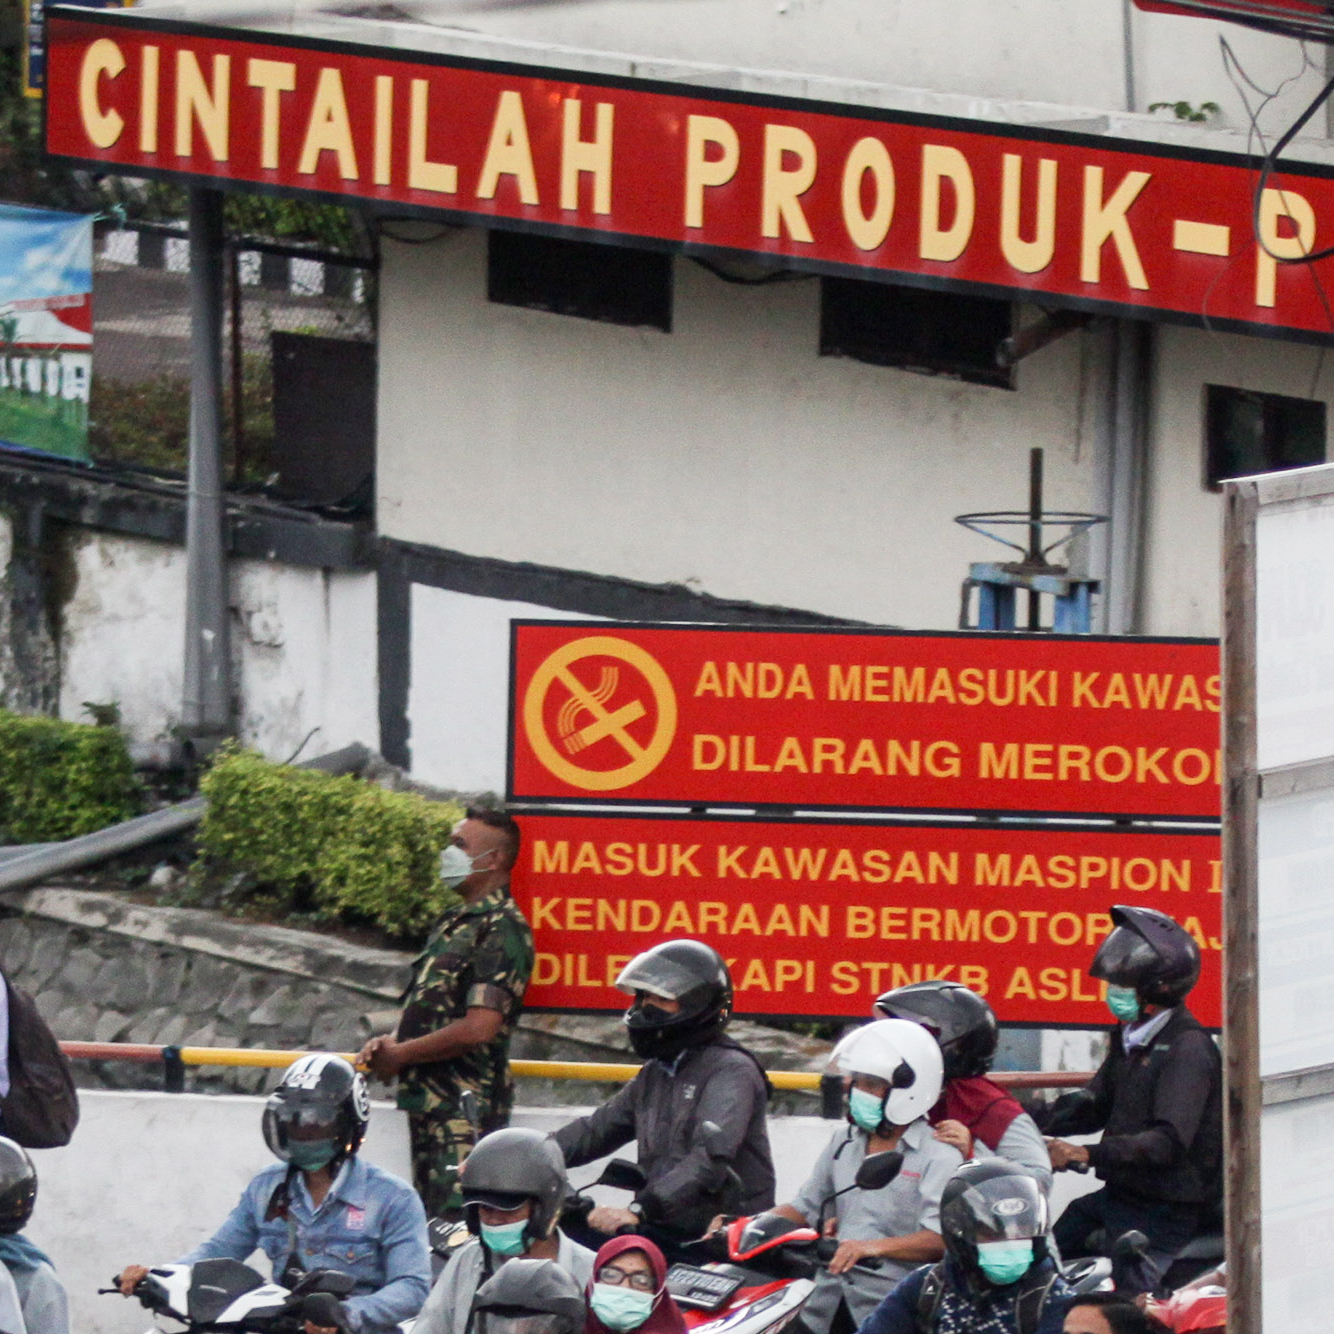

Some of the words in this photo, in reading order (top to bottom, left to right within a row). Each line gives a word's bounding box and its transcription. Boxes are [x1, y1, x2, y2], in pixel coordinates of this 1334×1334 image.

[79, 38, 615, 215] CINTAILAH
[695, 660, 816, 699] ANDA
[828, 664, 1060, 707] MEMASUKI
[692, 735, 962, 778] DILARANG
[979, 742, 1222, 785] MEROKO
[531, 840, 703, 878] MASUK
[717, 844, 961, 886] KAWASAN
[974, 851, 1192, 892] MASPION
[531, 898, 830, 939] KENDARAAN
[847, 905, 1114, 946] BERMOTOR
[532, 953, 815, 993] DILEKAPI
